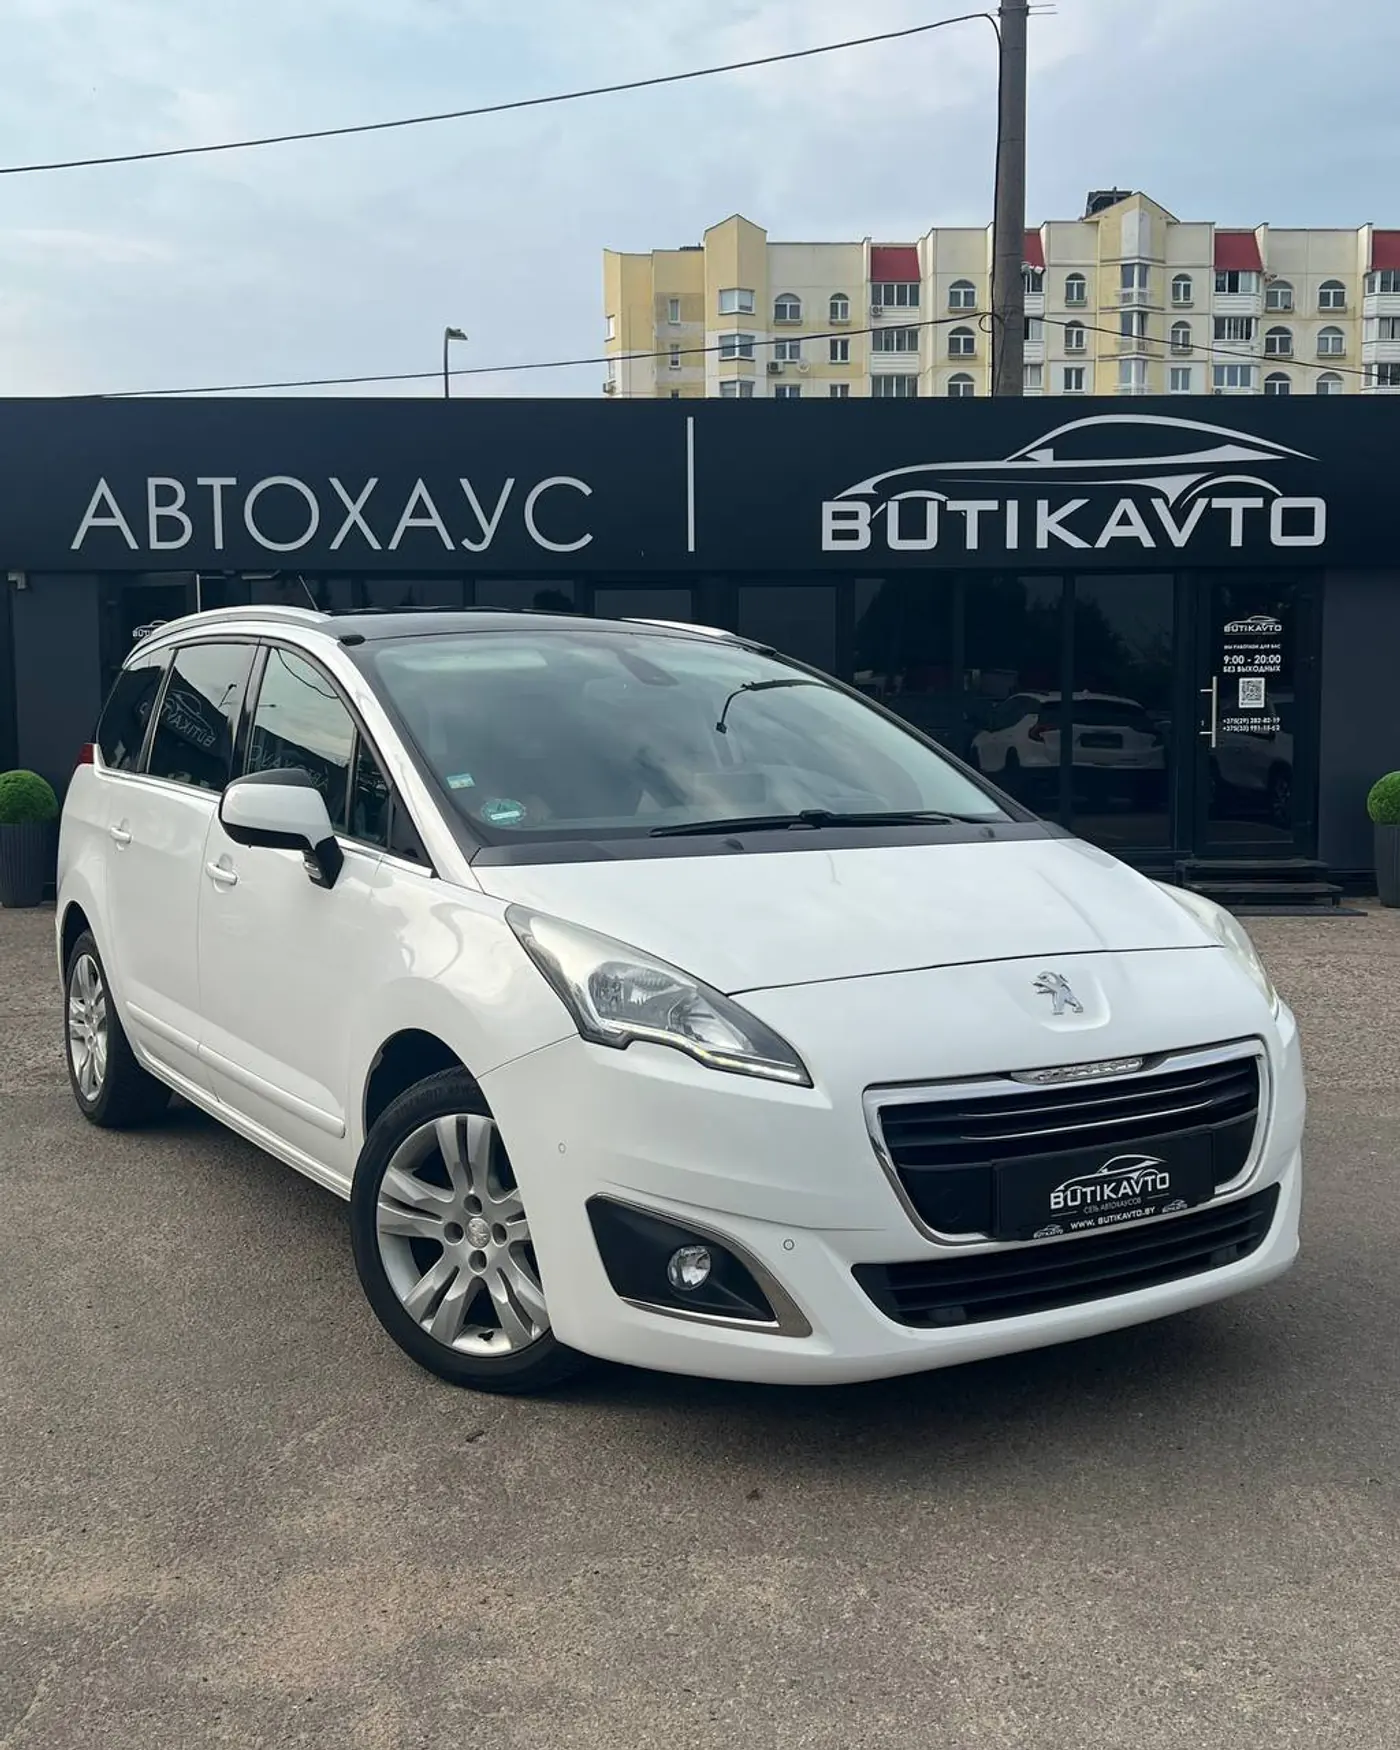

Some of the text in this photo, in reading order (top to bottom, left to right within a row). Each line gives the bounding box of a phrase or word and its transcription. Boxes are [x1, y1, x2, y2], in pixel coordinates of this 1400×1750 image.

[71, 476, 593, 552] АВТОХАУС
[821, 495, 1326, 552] BUTIKAVTO
[1223, 624, 1282, 633] BUTIKAVTO
[1223, 655, 1244, 665] 9:00
[1254, 654, 1281, 664] 20:00
[1223, 665, 1281, 673] БЕЗ ВЫХОДНЫХ
[1050, 1172, 1169, 1209] BUTIKAVTO
